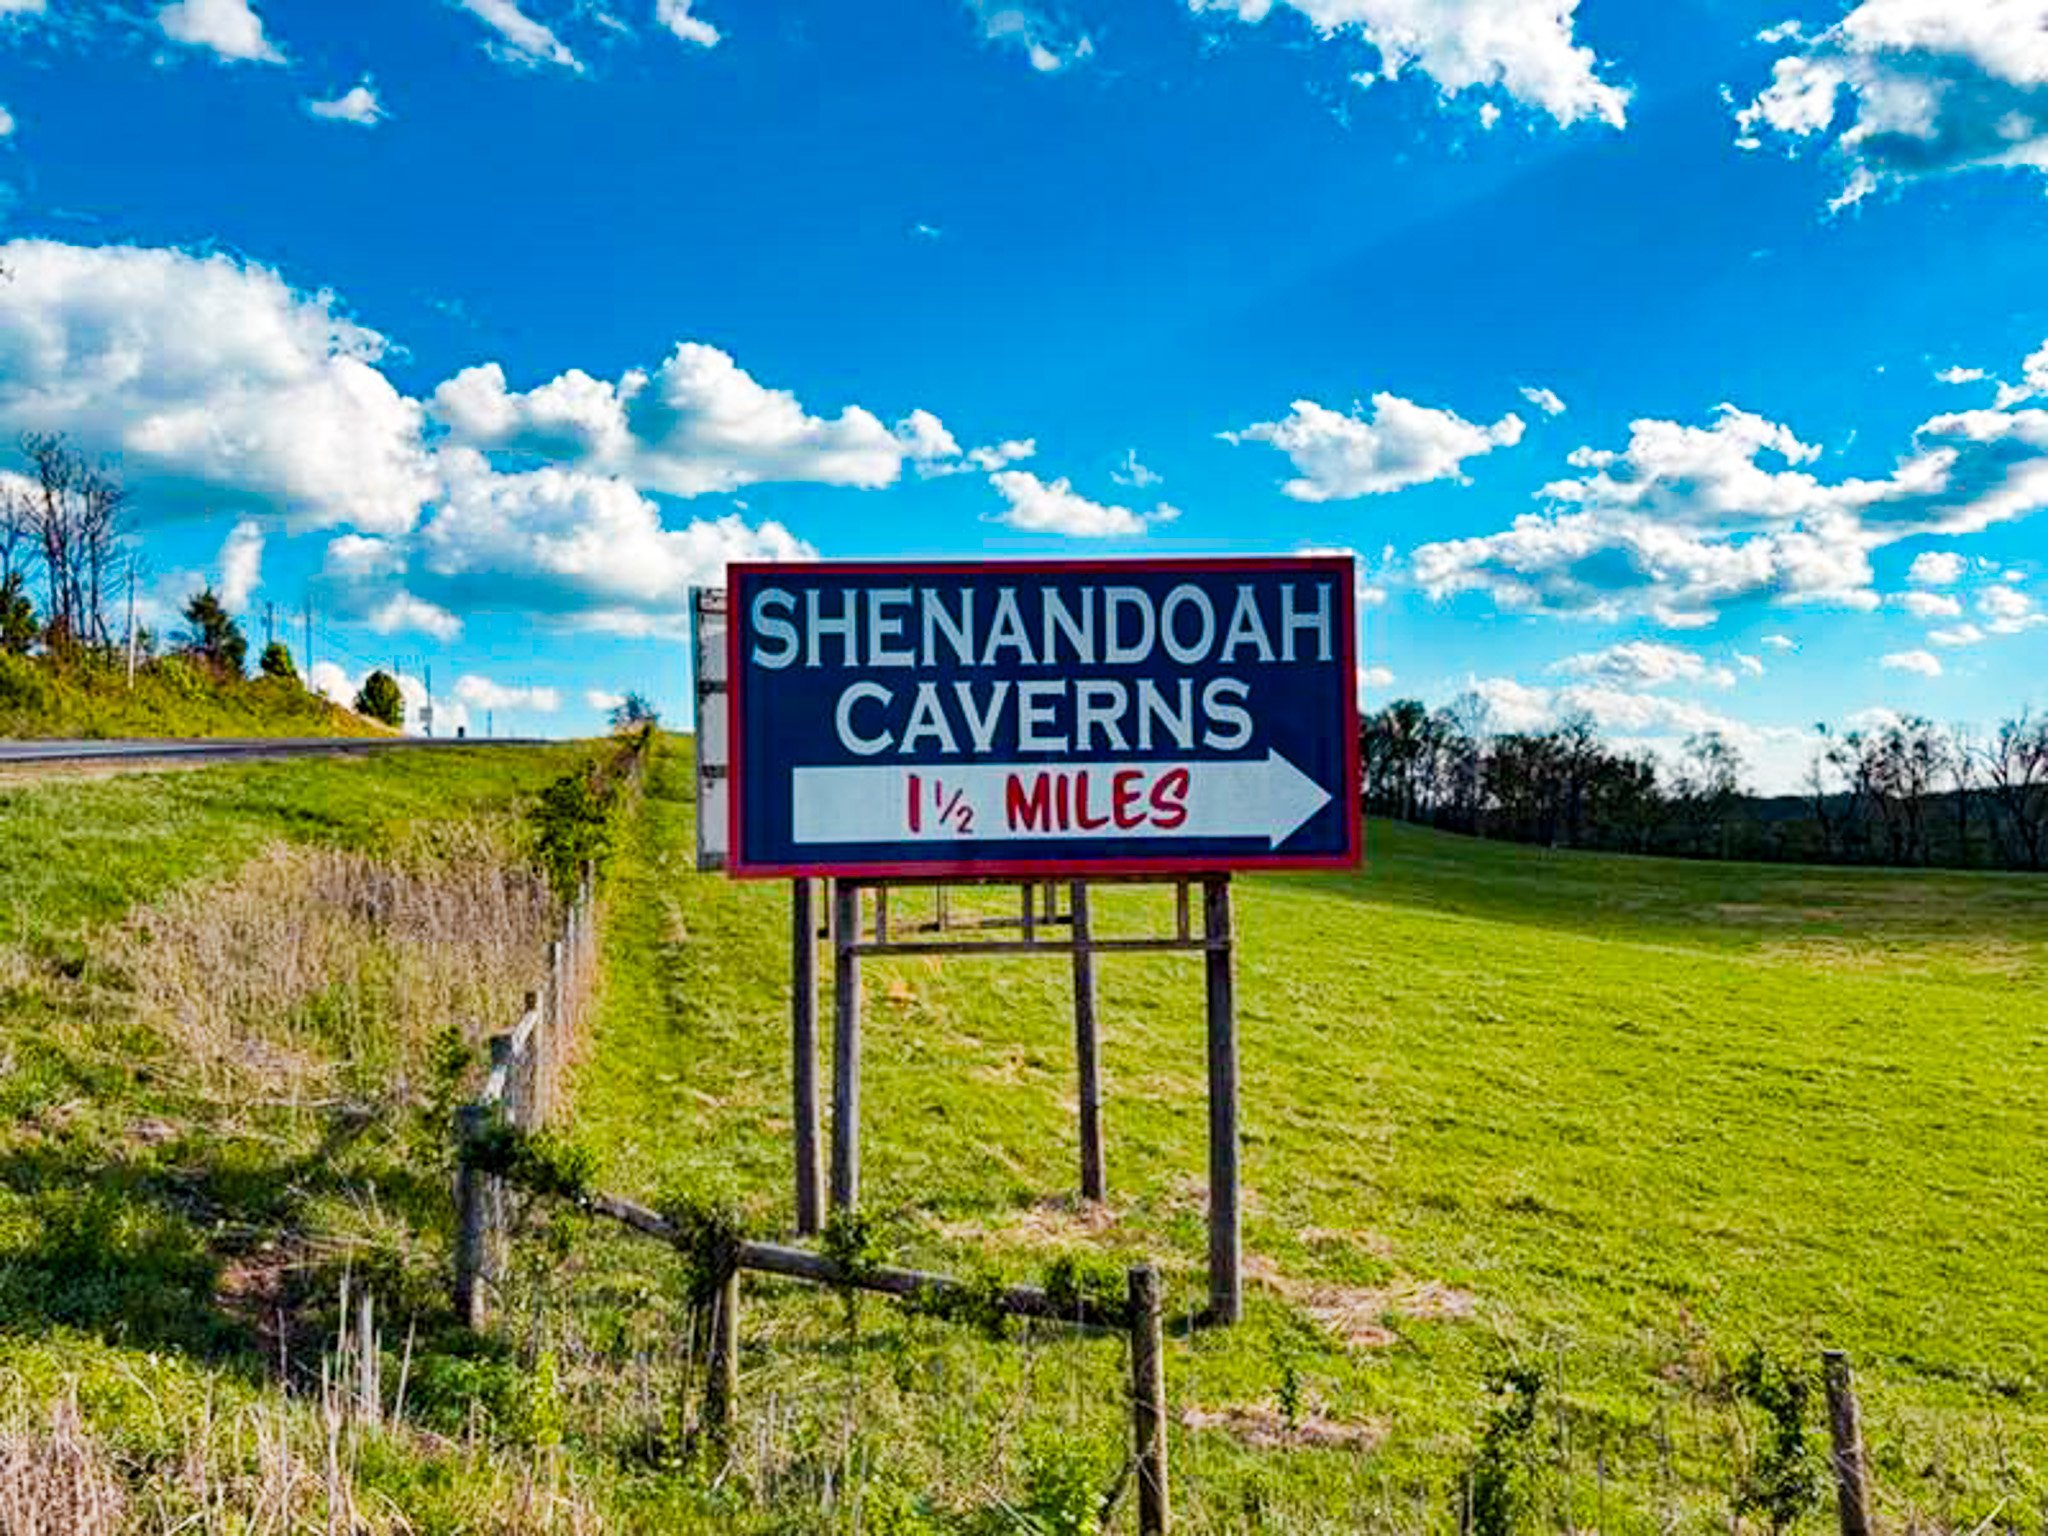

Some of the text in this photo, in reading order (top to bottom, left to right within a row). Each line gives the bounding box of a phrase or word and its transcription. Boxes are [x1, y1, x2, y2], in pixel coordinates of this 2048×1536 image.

[751, 583, 1334, 670] SHENANDOAH
[834, 677, 1254, 756] CAVERNS
[1006, 768, 1191, 831] MILES
